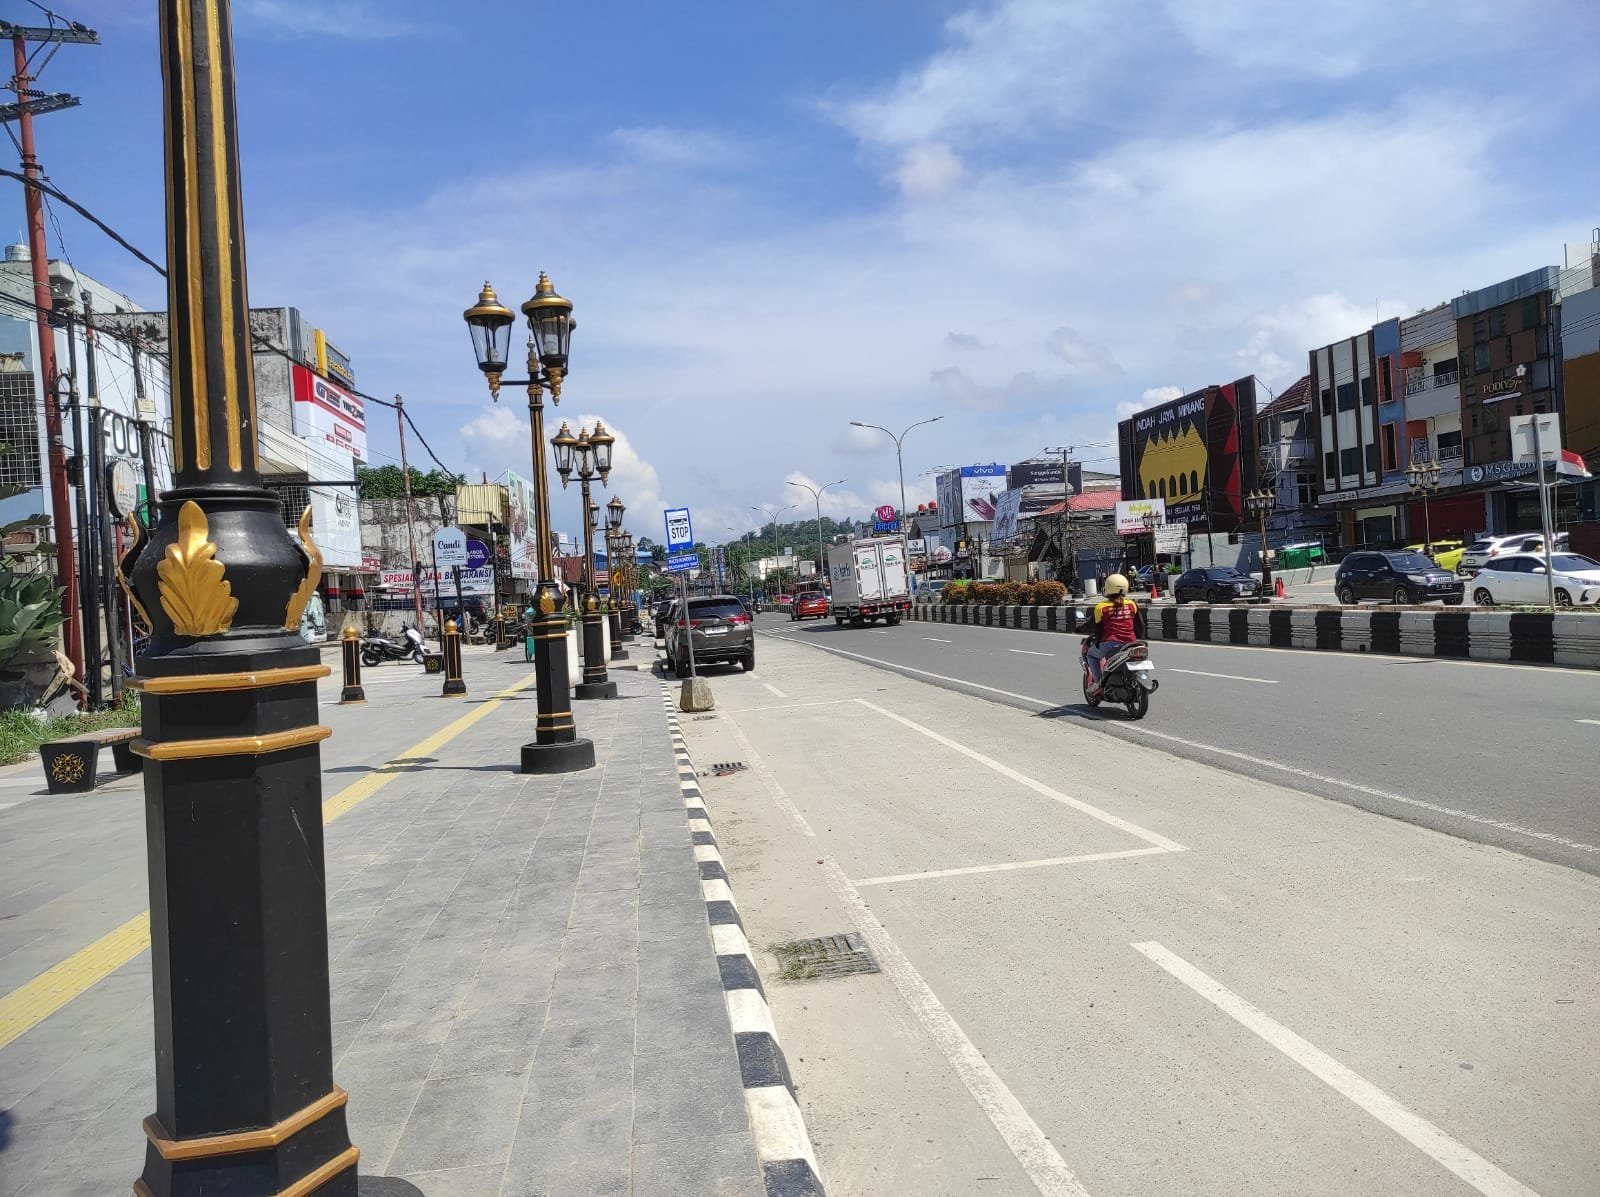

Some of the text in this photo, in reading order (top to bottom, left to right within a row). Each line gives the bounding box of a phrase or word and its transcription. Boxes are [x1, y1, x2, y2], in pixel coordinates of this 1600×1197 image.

[1136, 398, 1205, 432] INDAH JAYA MINANG
[974, 466, 994, 474] vivo
[671, 526, 689, 539] STOP
[437, 540, 460, 550] Candi
[425, 571, 442, 580] JAA
[444, 568, 492, 580] BEGARANSI
